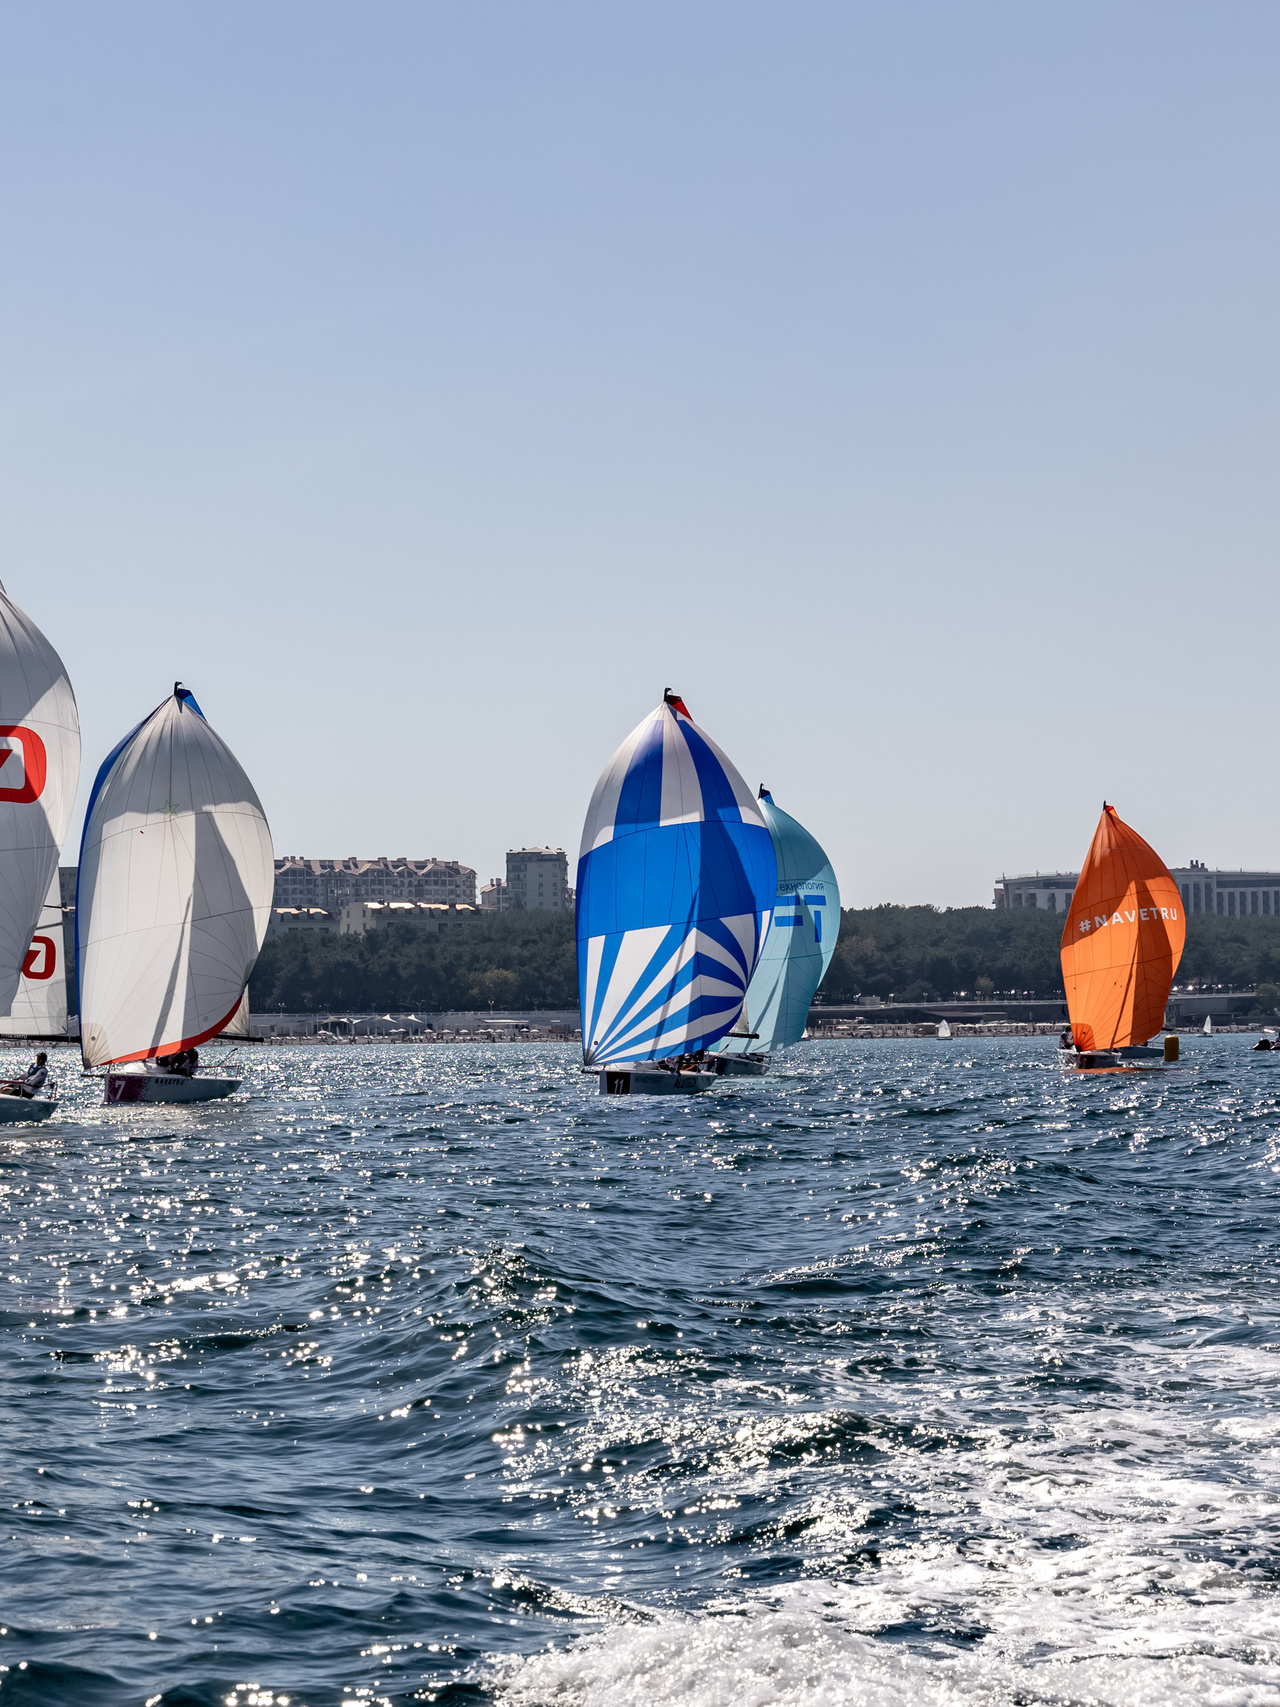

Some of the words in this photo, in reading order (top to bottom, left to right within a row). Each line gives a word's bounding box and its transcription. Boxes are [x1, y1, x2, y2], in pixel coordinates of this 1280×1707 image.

[1079, 907, 1178, 932] #NAVETRU
[114, 1080, 126, 1099] 7
[614, 1079, 624, 1095] 11
